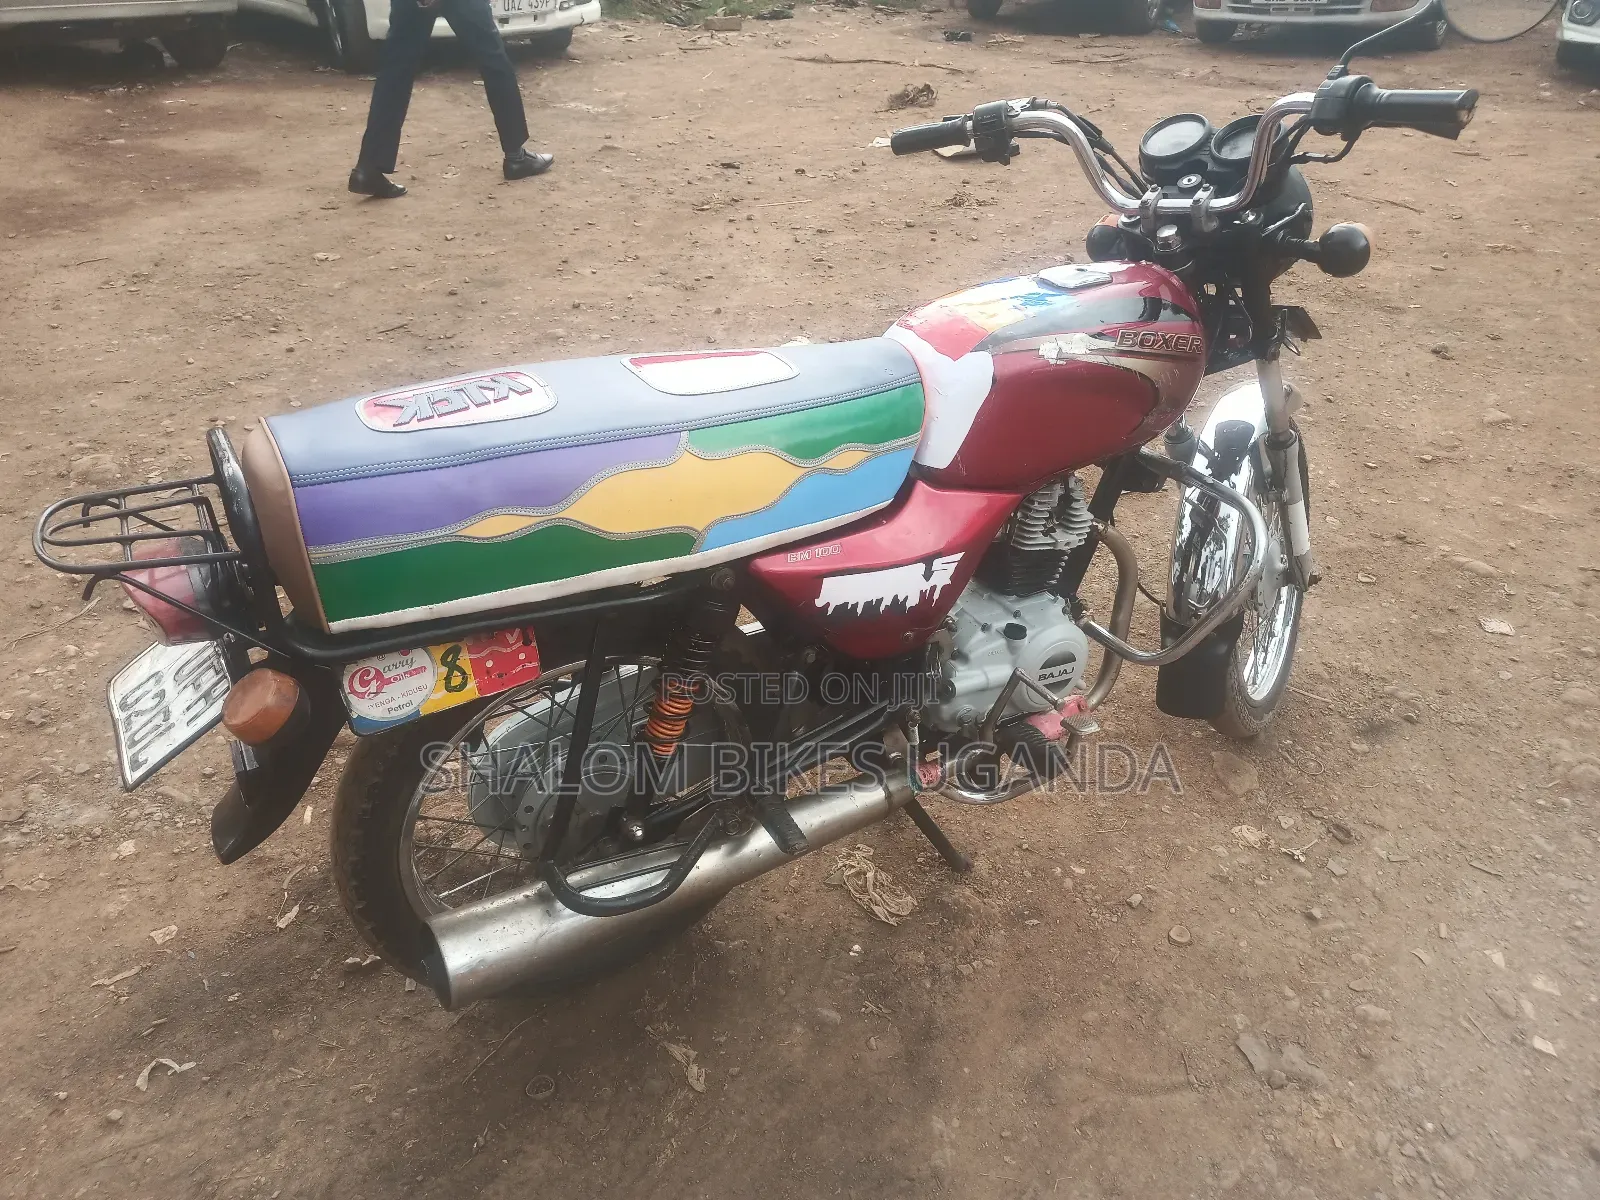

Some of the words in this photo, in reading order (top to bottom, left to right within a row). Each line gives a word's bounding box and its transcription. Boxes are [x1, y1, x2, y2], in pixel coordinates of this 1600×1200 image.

[1114, 328, 1203, 353] BOXER
[374, 375, 533, 427] KICK
[787, 549, 812, 563] BM
[815, 544, 841, 558] 100
[440, 644, 468, 693] 8
[1038, 666, 1075, 681] BAJAJ
[387, 700, 414, 714] Petrol
